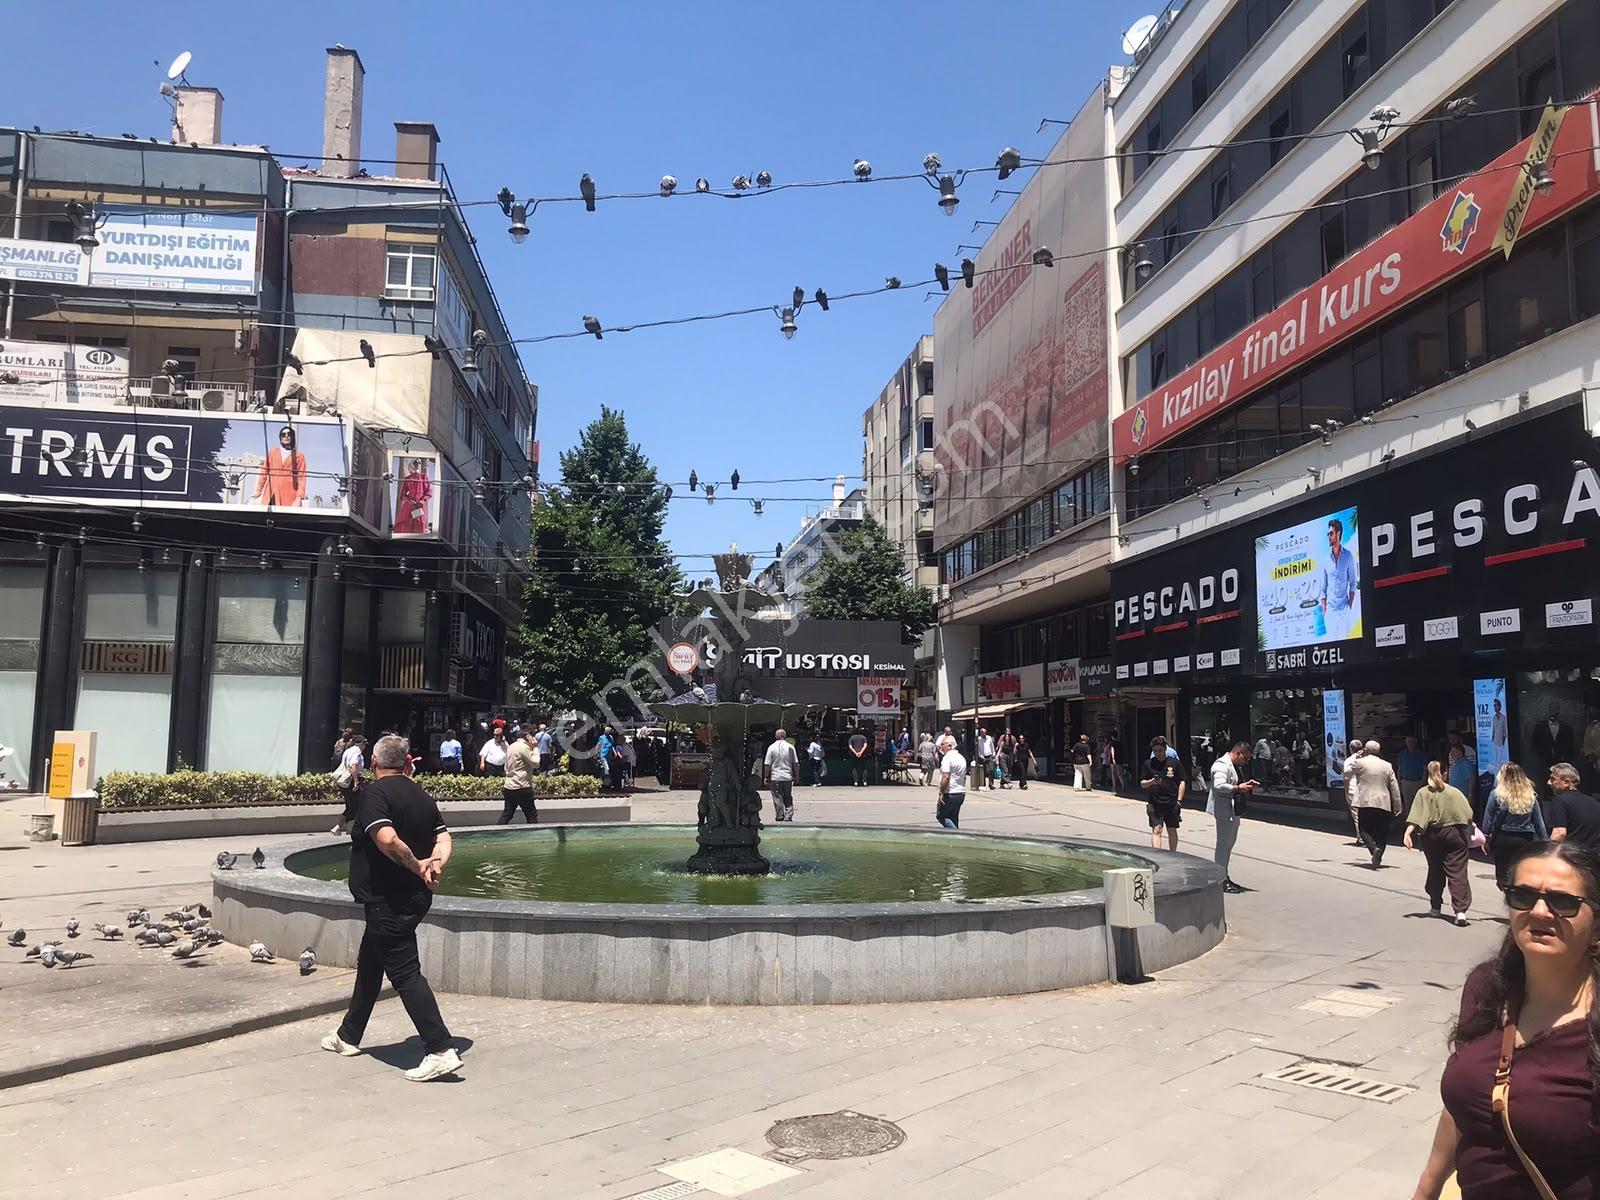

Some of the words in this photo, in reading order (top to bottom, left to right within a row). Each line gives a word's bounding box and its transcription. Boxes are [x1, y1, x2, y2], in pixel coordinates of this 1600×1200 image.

[100, 231, 183, 250] YURTDIŞI
[186, 233, 250, 252] EĞİTİM
[105, 251, 242, 270] DANIŞMANLIĞI
[1162, 358, 1234, 428] kızılay
[1242, 299, 1308, 380] final
[1318, 252, 1402, 335] kurs
[6, 427, 174, 481] TRMS
[1371, 467, 1600, 567] PESCA
[1275, 535, 1310, 550] PESCADO
[1274, 559, 1312, 579] İNDİRİMİ
[1114, 568, 1239, 628] PESCADO
[1486, 616, 1513, 628] PUNTO
[112, 653, 138, 664] KG
[785, 652, 870, 670] USTASI
[873, 662, 906, 671] KESİMAL
[1277, 648, 1307, 669] SABRİ
[1312, 646, 1344, 666] ÖZEL
[875, 687, 894, 708] 15
[1477, 703, 1489, 715] YAZ
